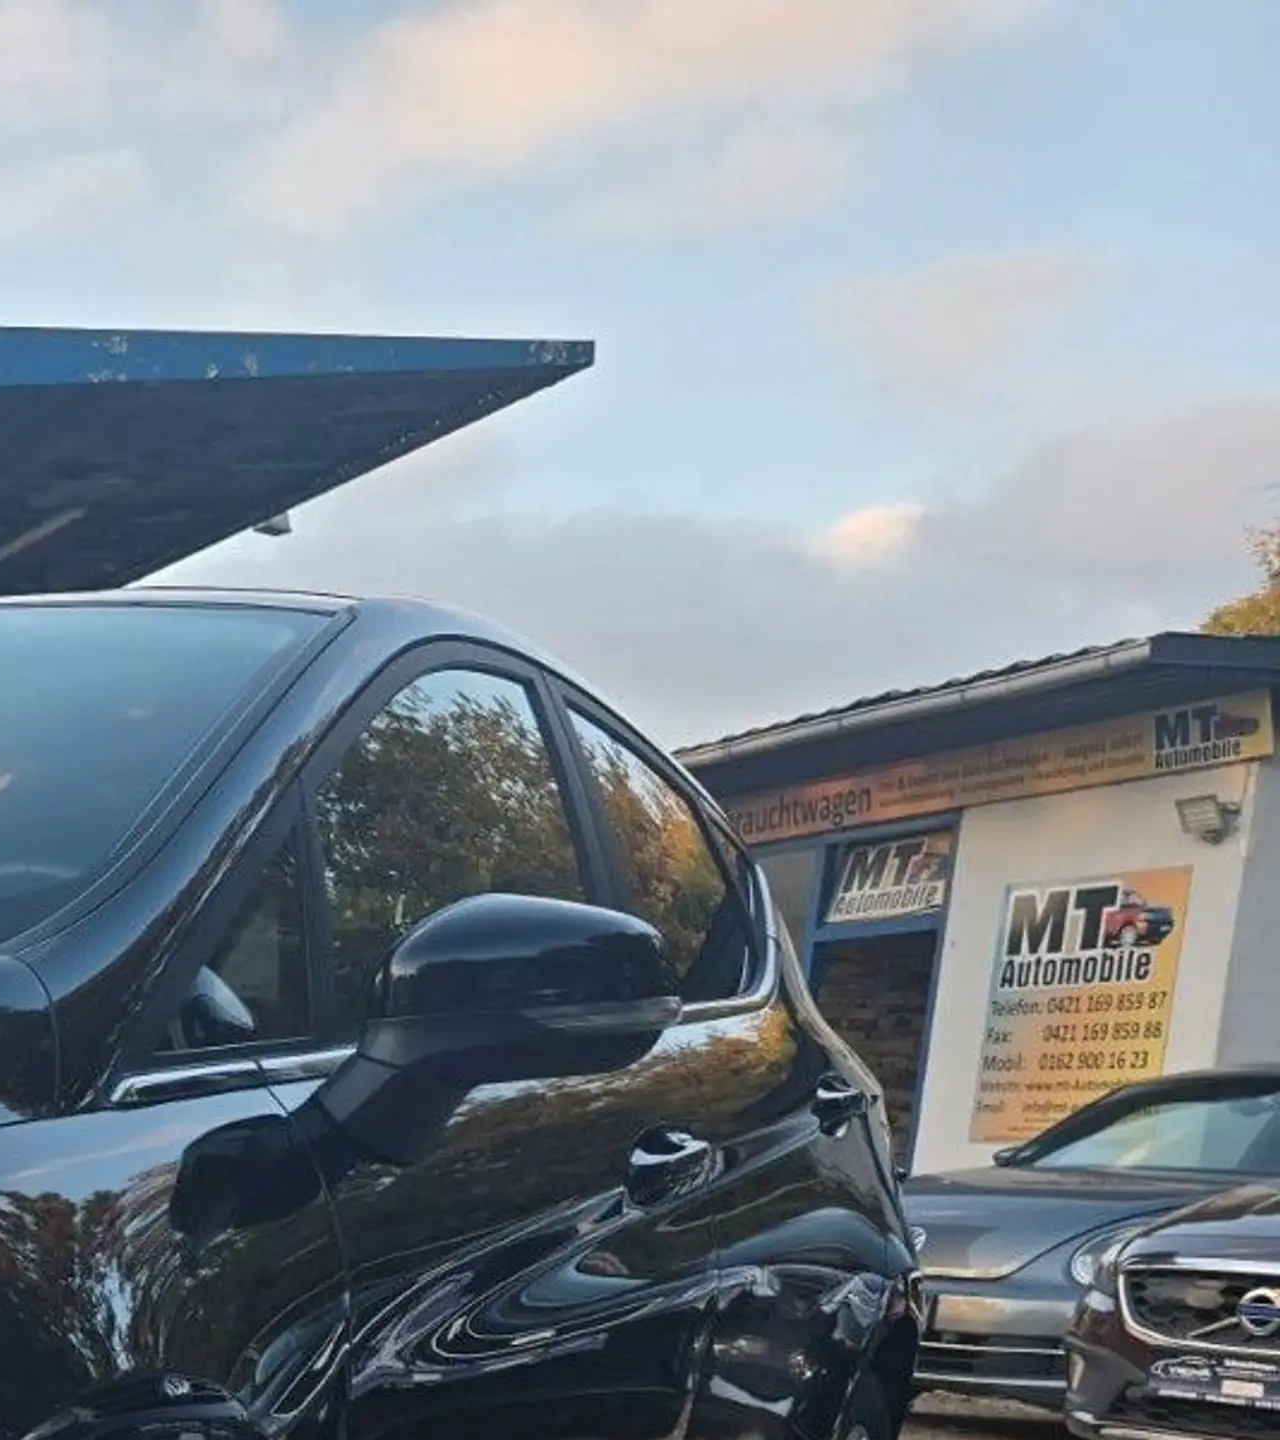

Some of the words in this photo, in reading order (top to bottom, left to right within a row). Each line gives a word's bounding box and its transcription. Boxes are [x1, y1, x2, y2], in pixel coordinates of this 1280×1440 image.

[1154, 704, 1217, 751] MT
[1155, 739, 1241, 769] Automobile
[841, 841, 926, 893] MT
[1006, 886, 1118, 955] MT
[1000, 951, 1151, 988] Automobile
[1046, 995, 1081, 1014] 0421
[1042, 1023, 1076, 1042] 0421
[1082, 1021, 1109, 1041] 169
[1107, 1051, 1126, 1070] 16
[1129, 1050, 1149, 1070] 23
